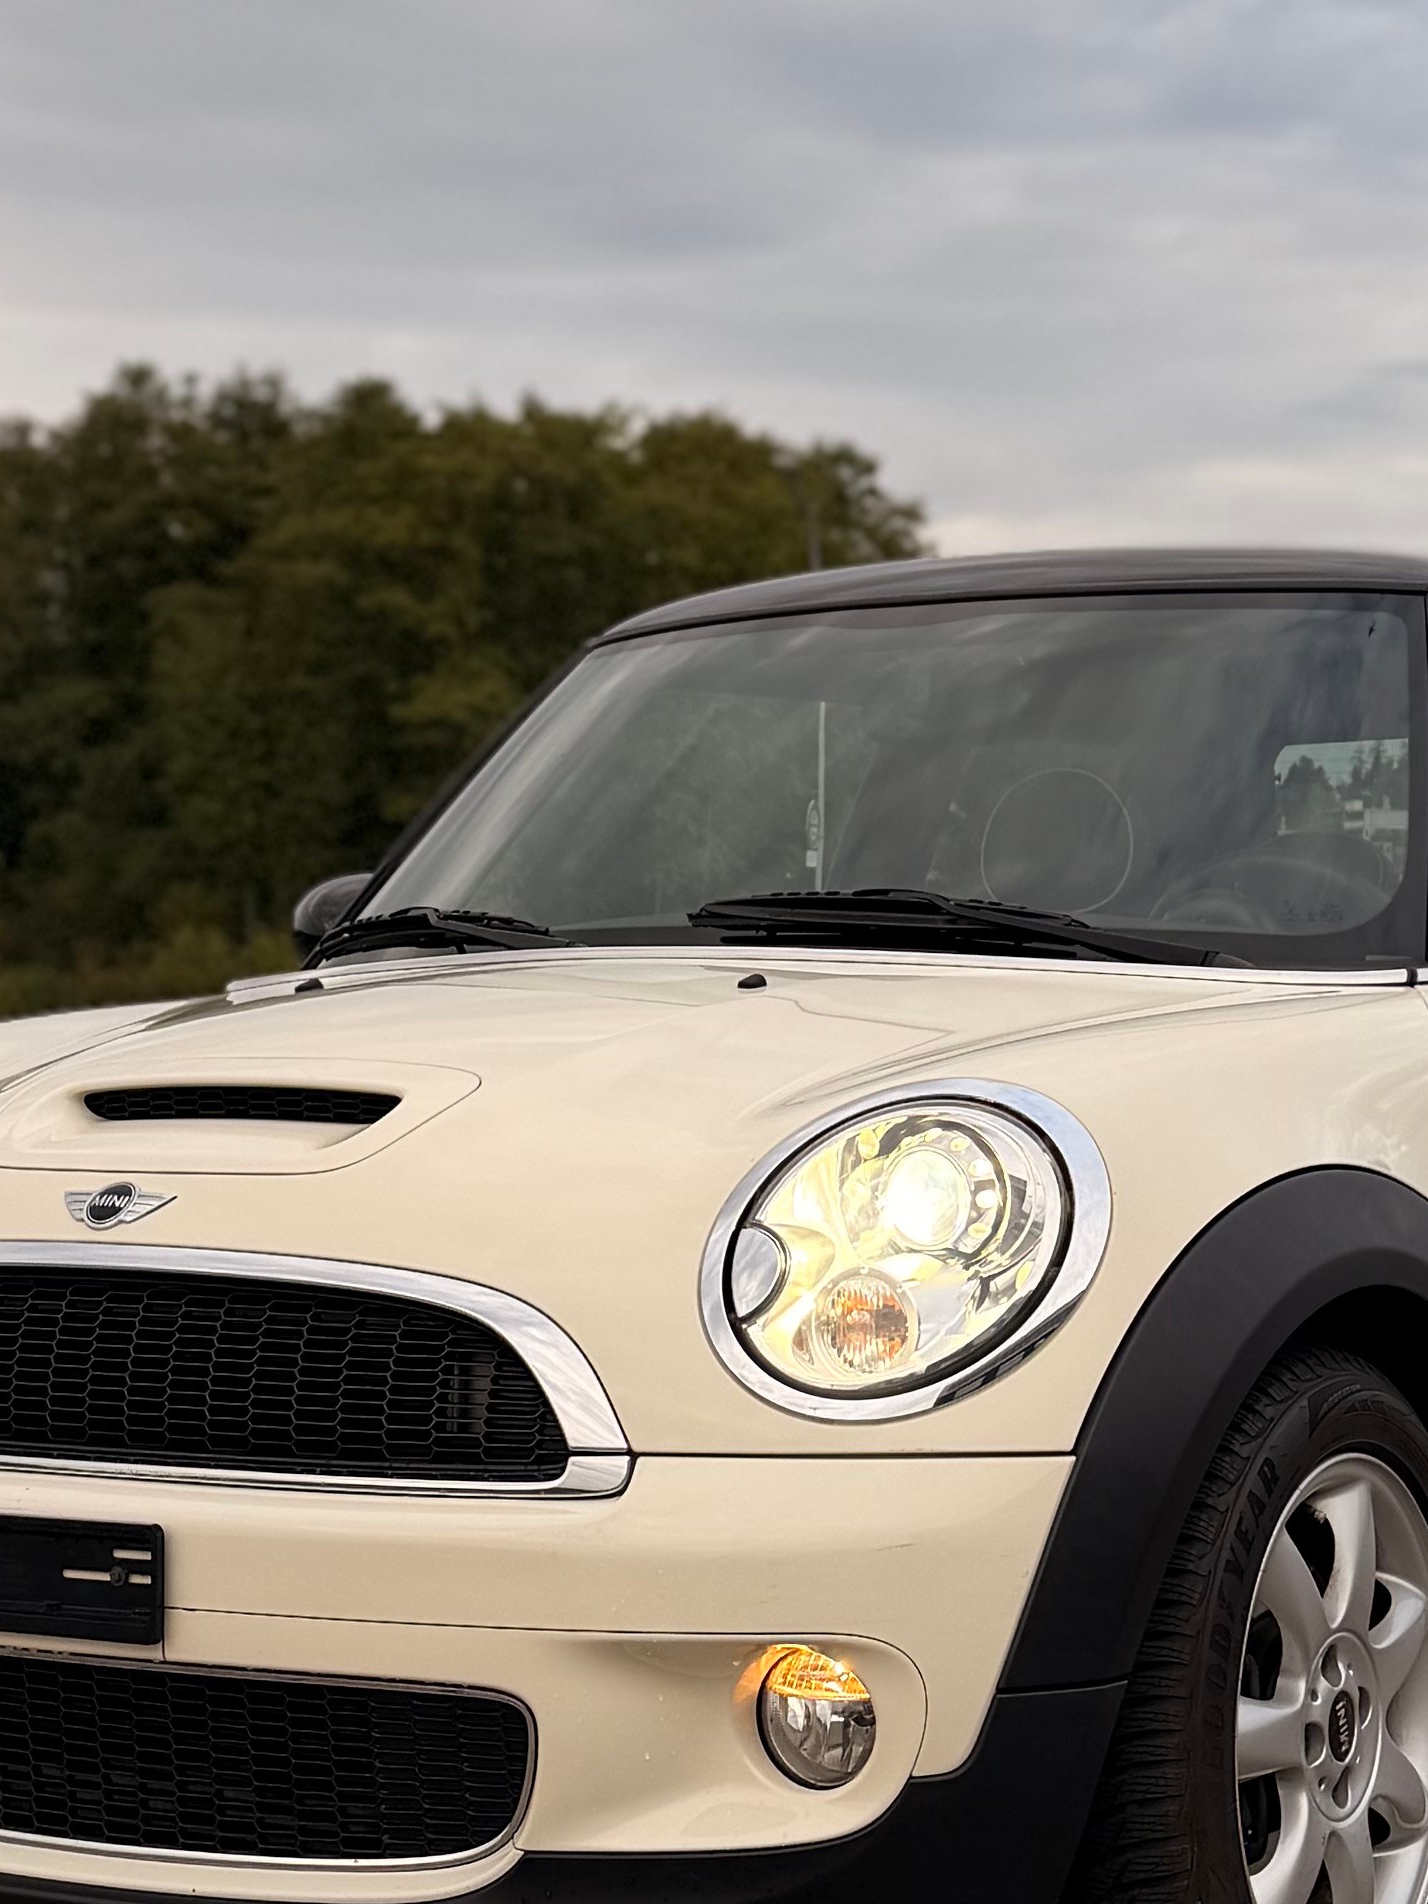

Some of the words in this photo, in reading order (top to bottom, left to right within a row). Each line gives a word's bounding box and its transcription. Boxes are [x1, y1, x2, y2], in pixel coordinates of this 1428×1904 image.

[90, 1193, 132, 1209] MINI
[1202, 1456, 1280, 1772] GOODYEAR
[1335, 1699, 1349, 1753] MINI
